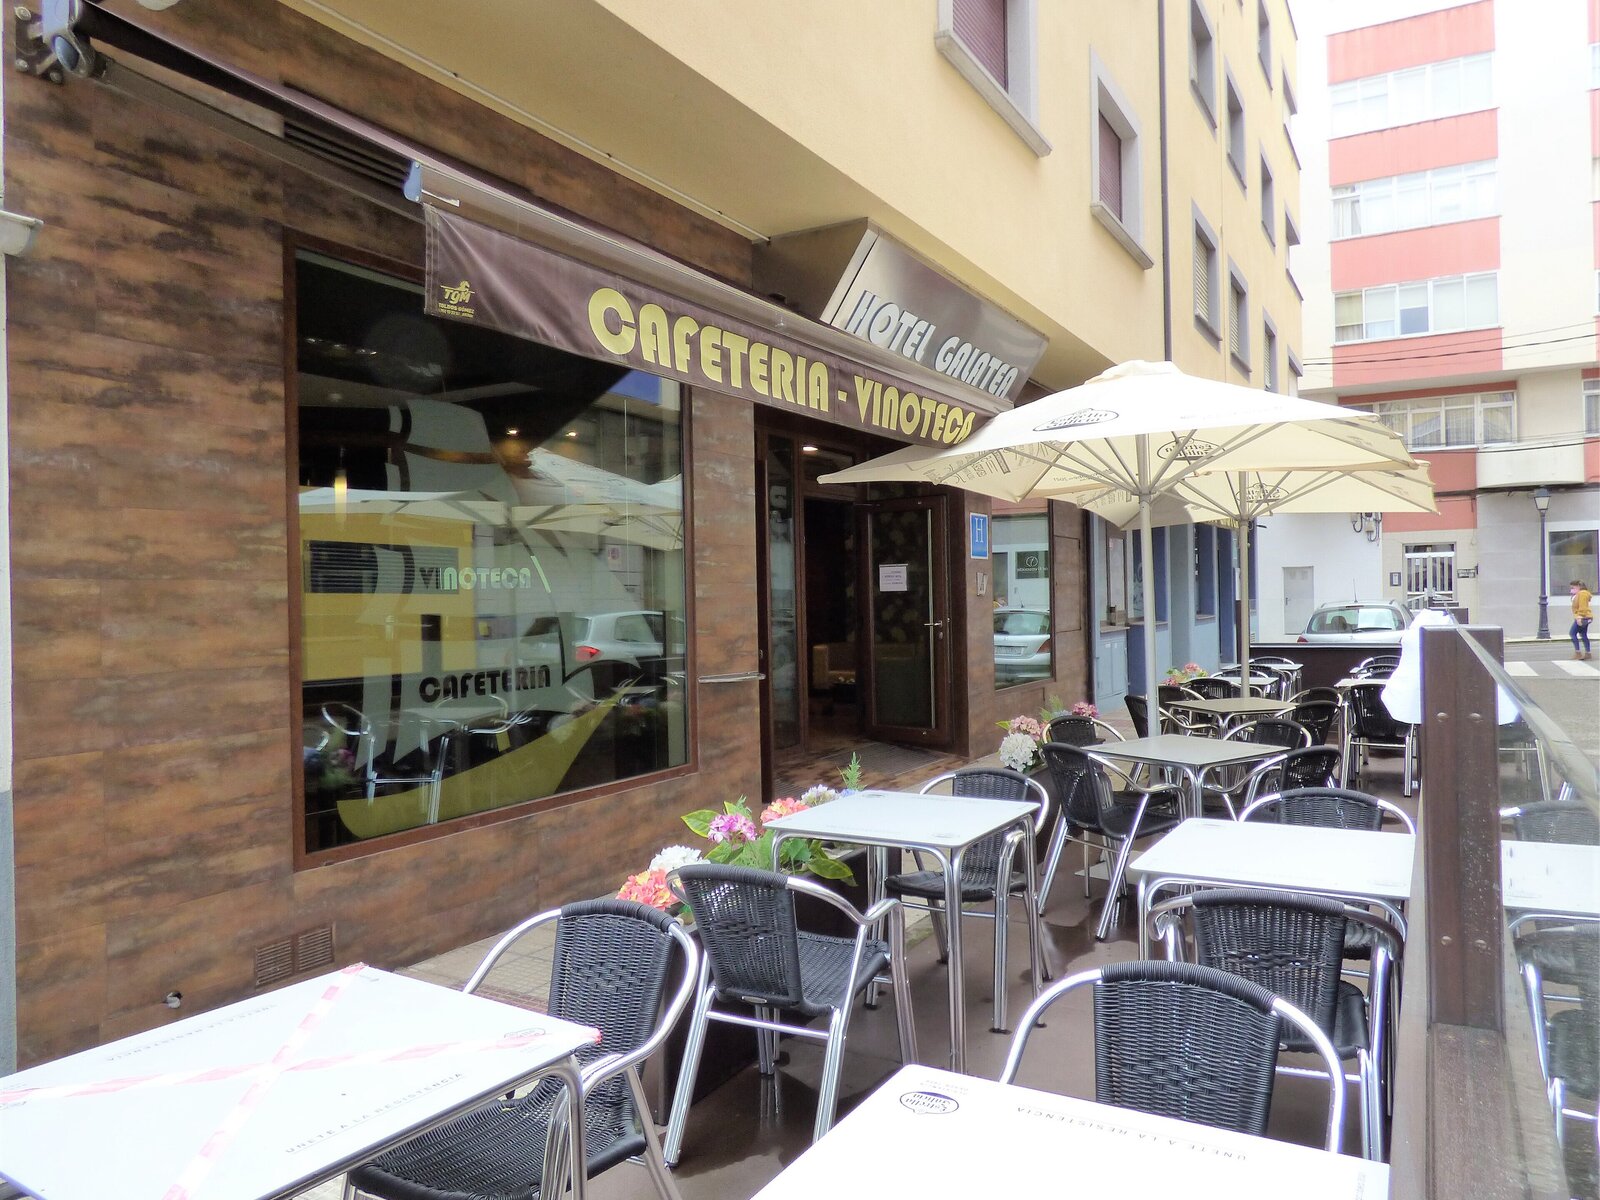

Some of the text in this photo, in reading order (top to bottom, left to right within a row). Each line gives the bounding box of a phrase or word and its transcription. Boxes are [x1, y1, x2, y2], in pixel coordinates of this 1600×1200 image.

[844, 289, 1019, 400] HOTEL GALATEA
[587, 287, 830, 413] CAFETERIA
[853, 375, 977, 445] VINOTECA
[974, 517, 985, 543] H
[419, 567, 532, 591] VINOTECA
[418, 664, 551, 704] CAFETERIA
